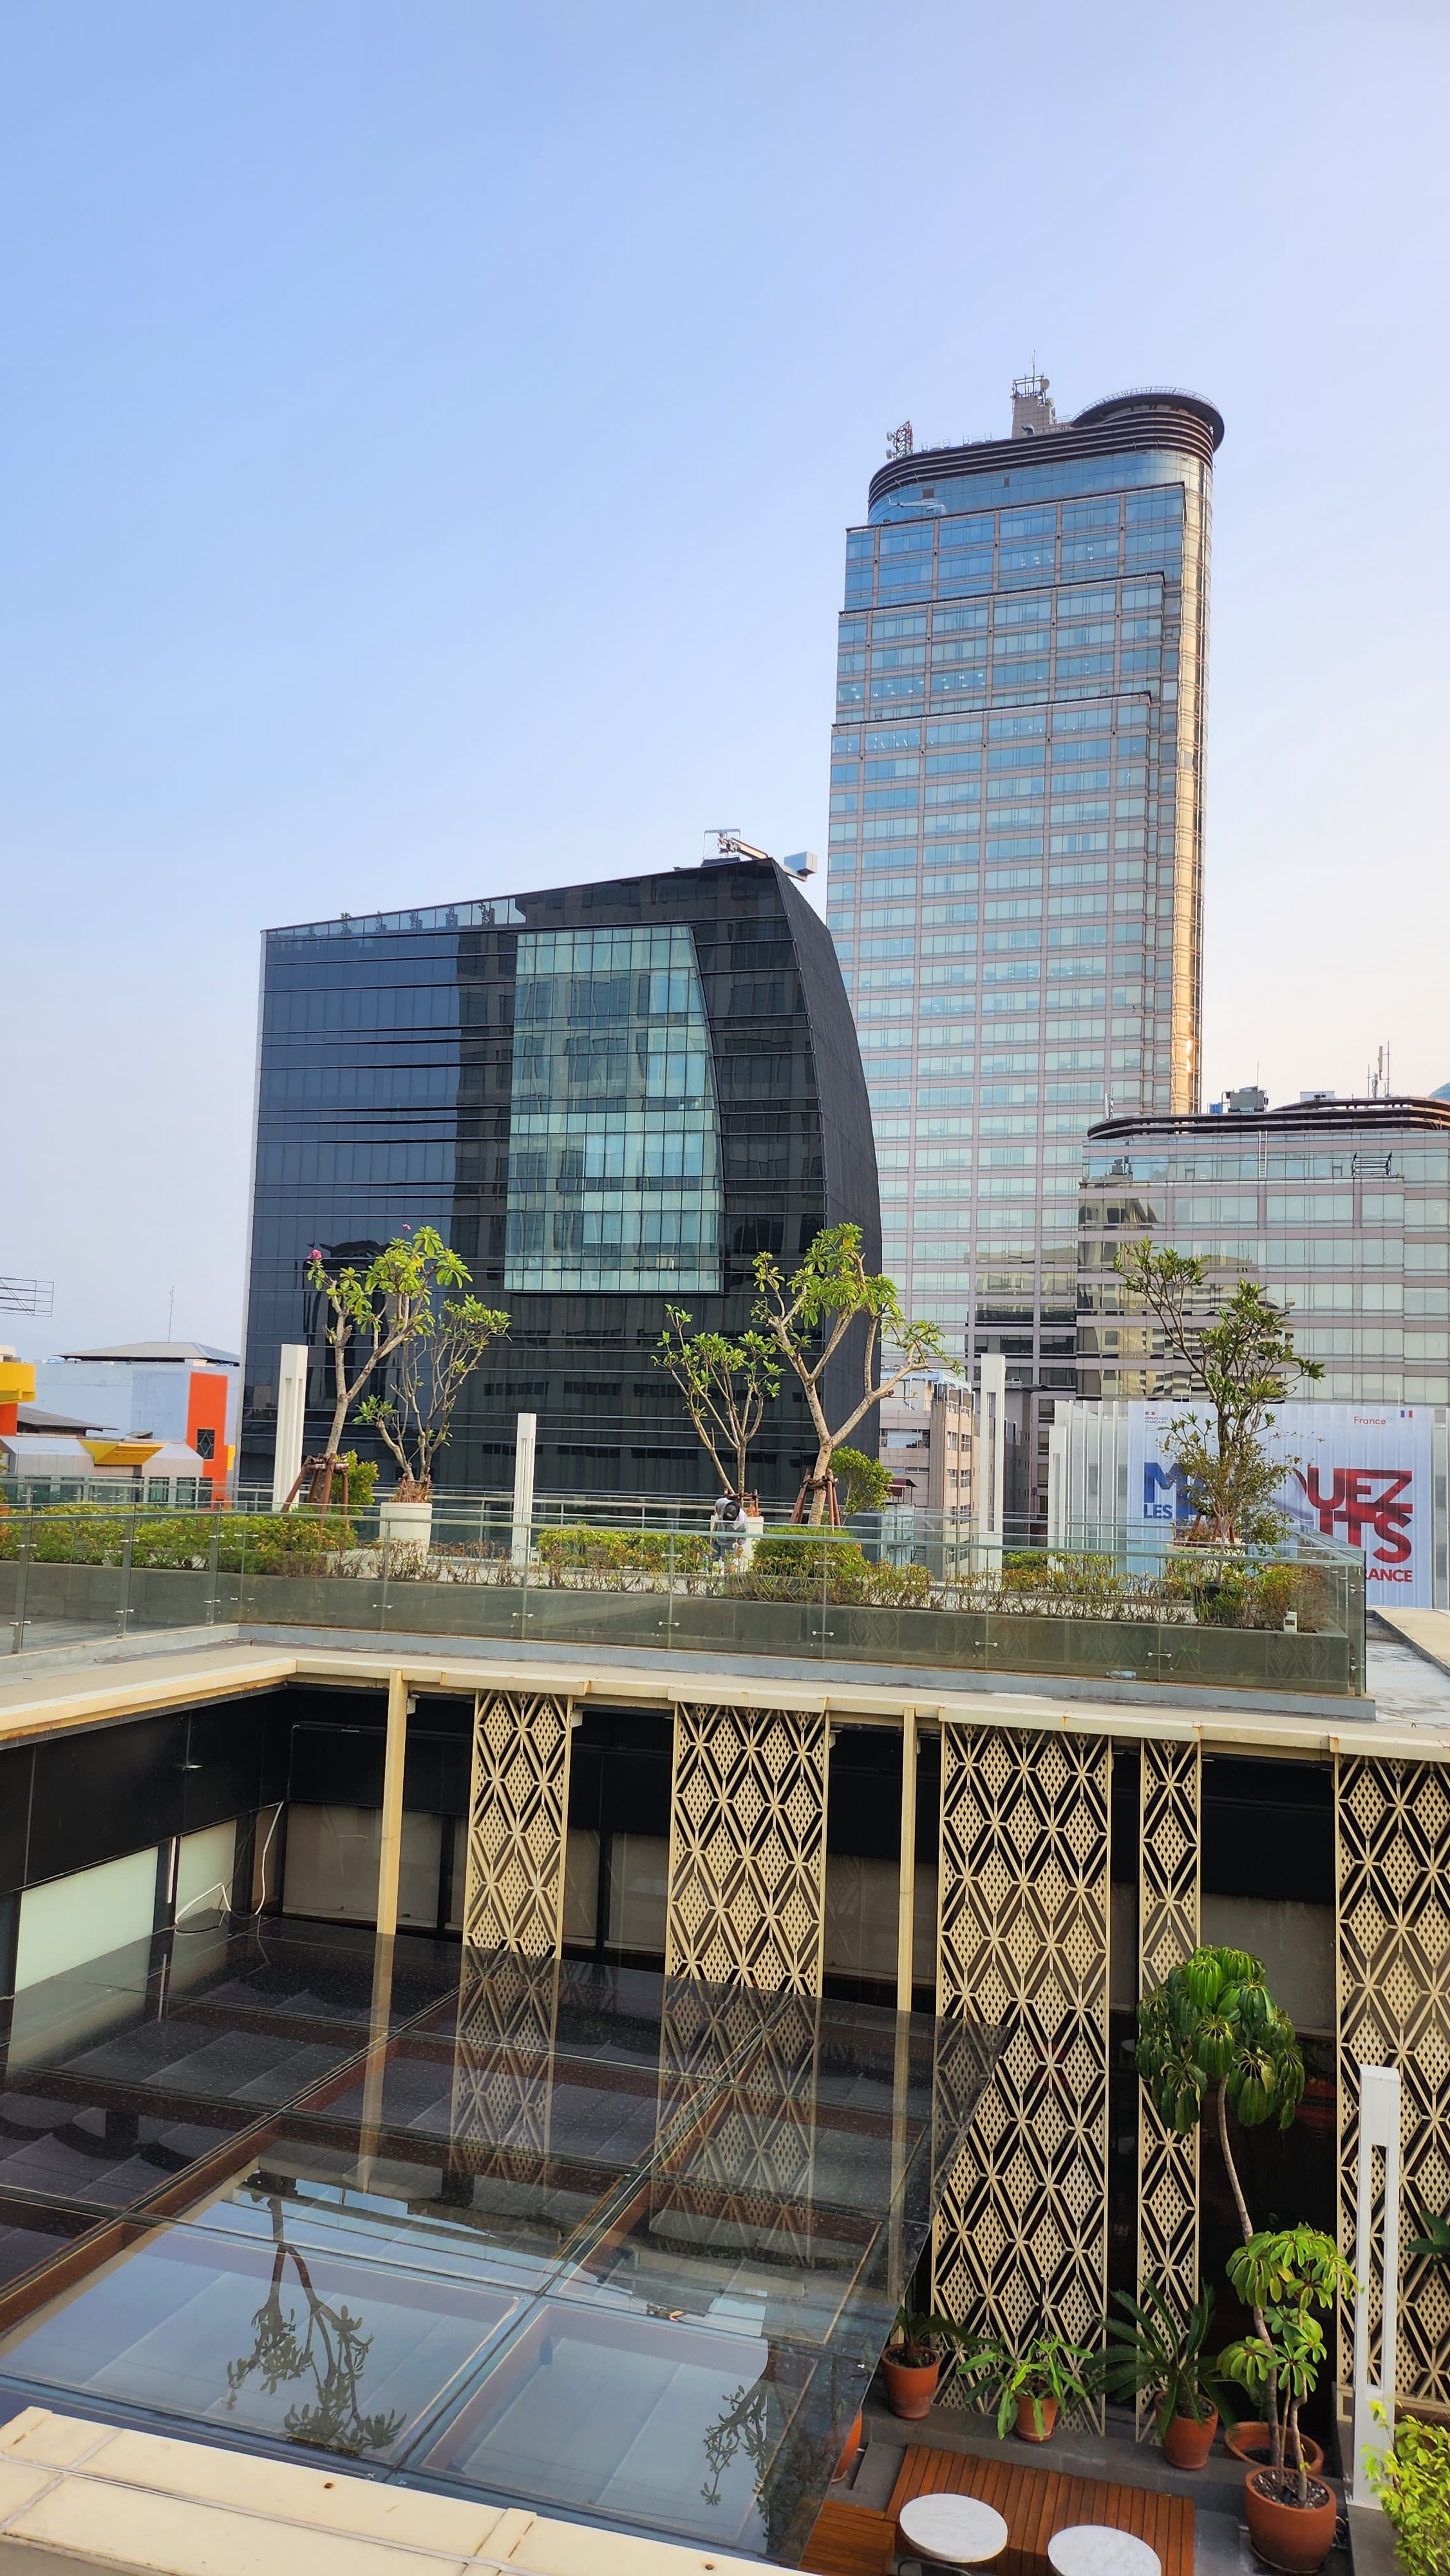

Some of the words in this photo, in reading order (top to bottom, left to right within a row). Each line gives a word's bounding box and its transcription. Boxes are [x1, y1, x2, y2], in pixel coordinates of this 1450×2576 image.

[1354, 1416, 1386, 1425] France
[1144, 1504, 1173, 1519] LES
[1366, 1568, 1413, 1582] ANCE
